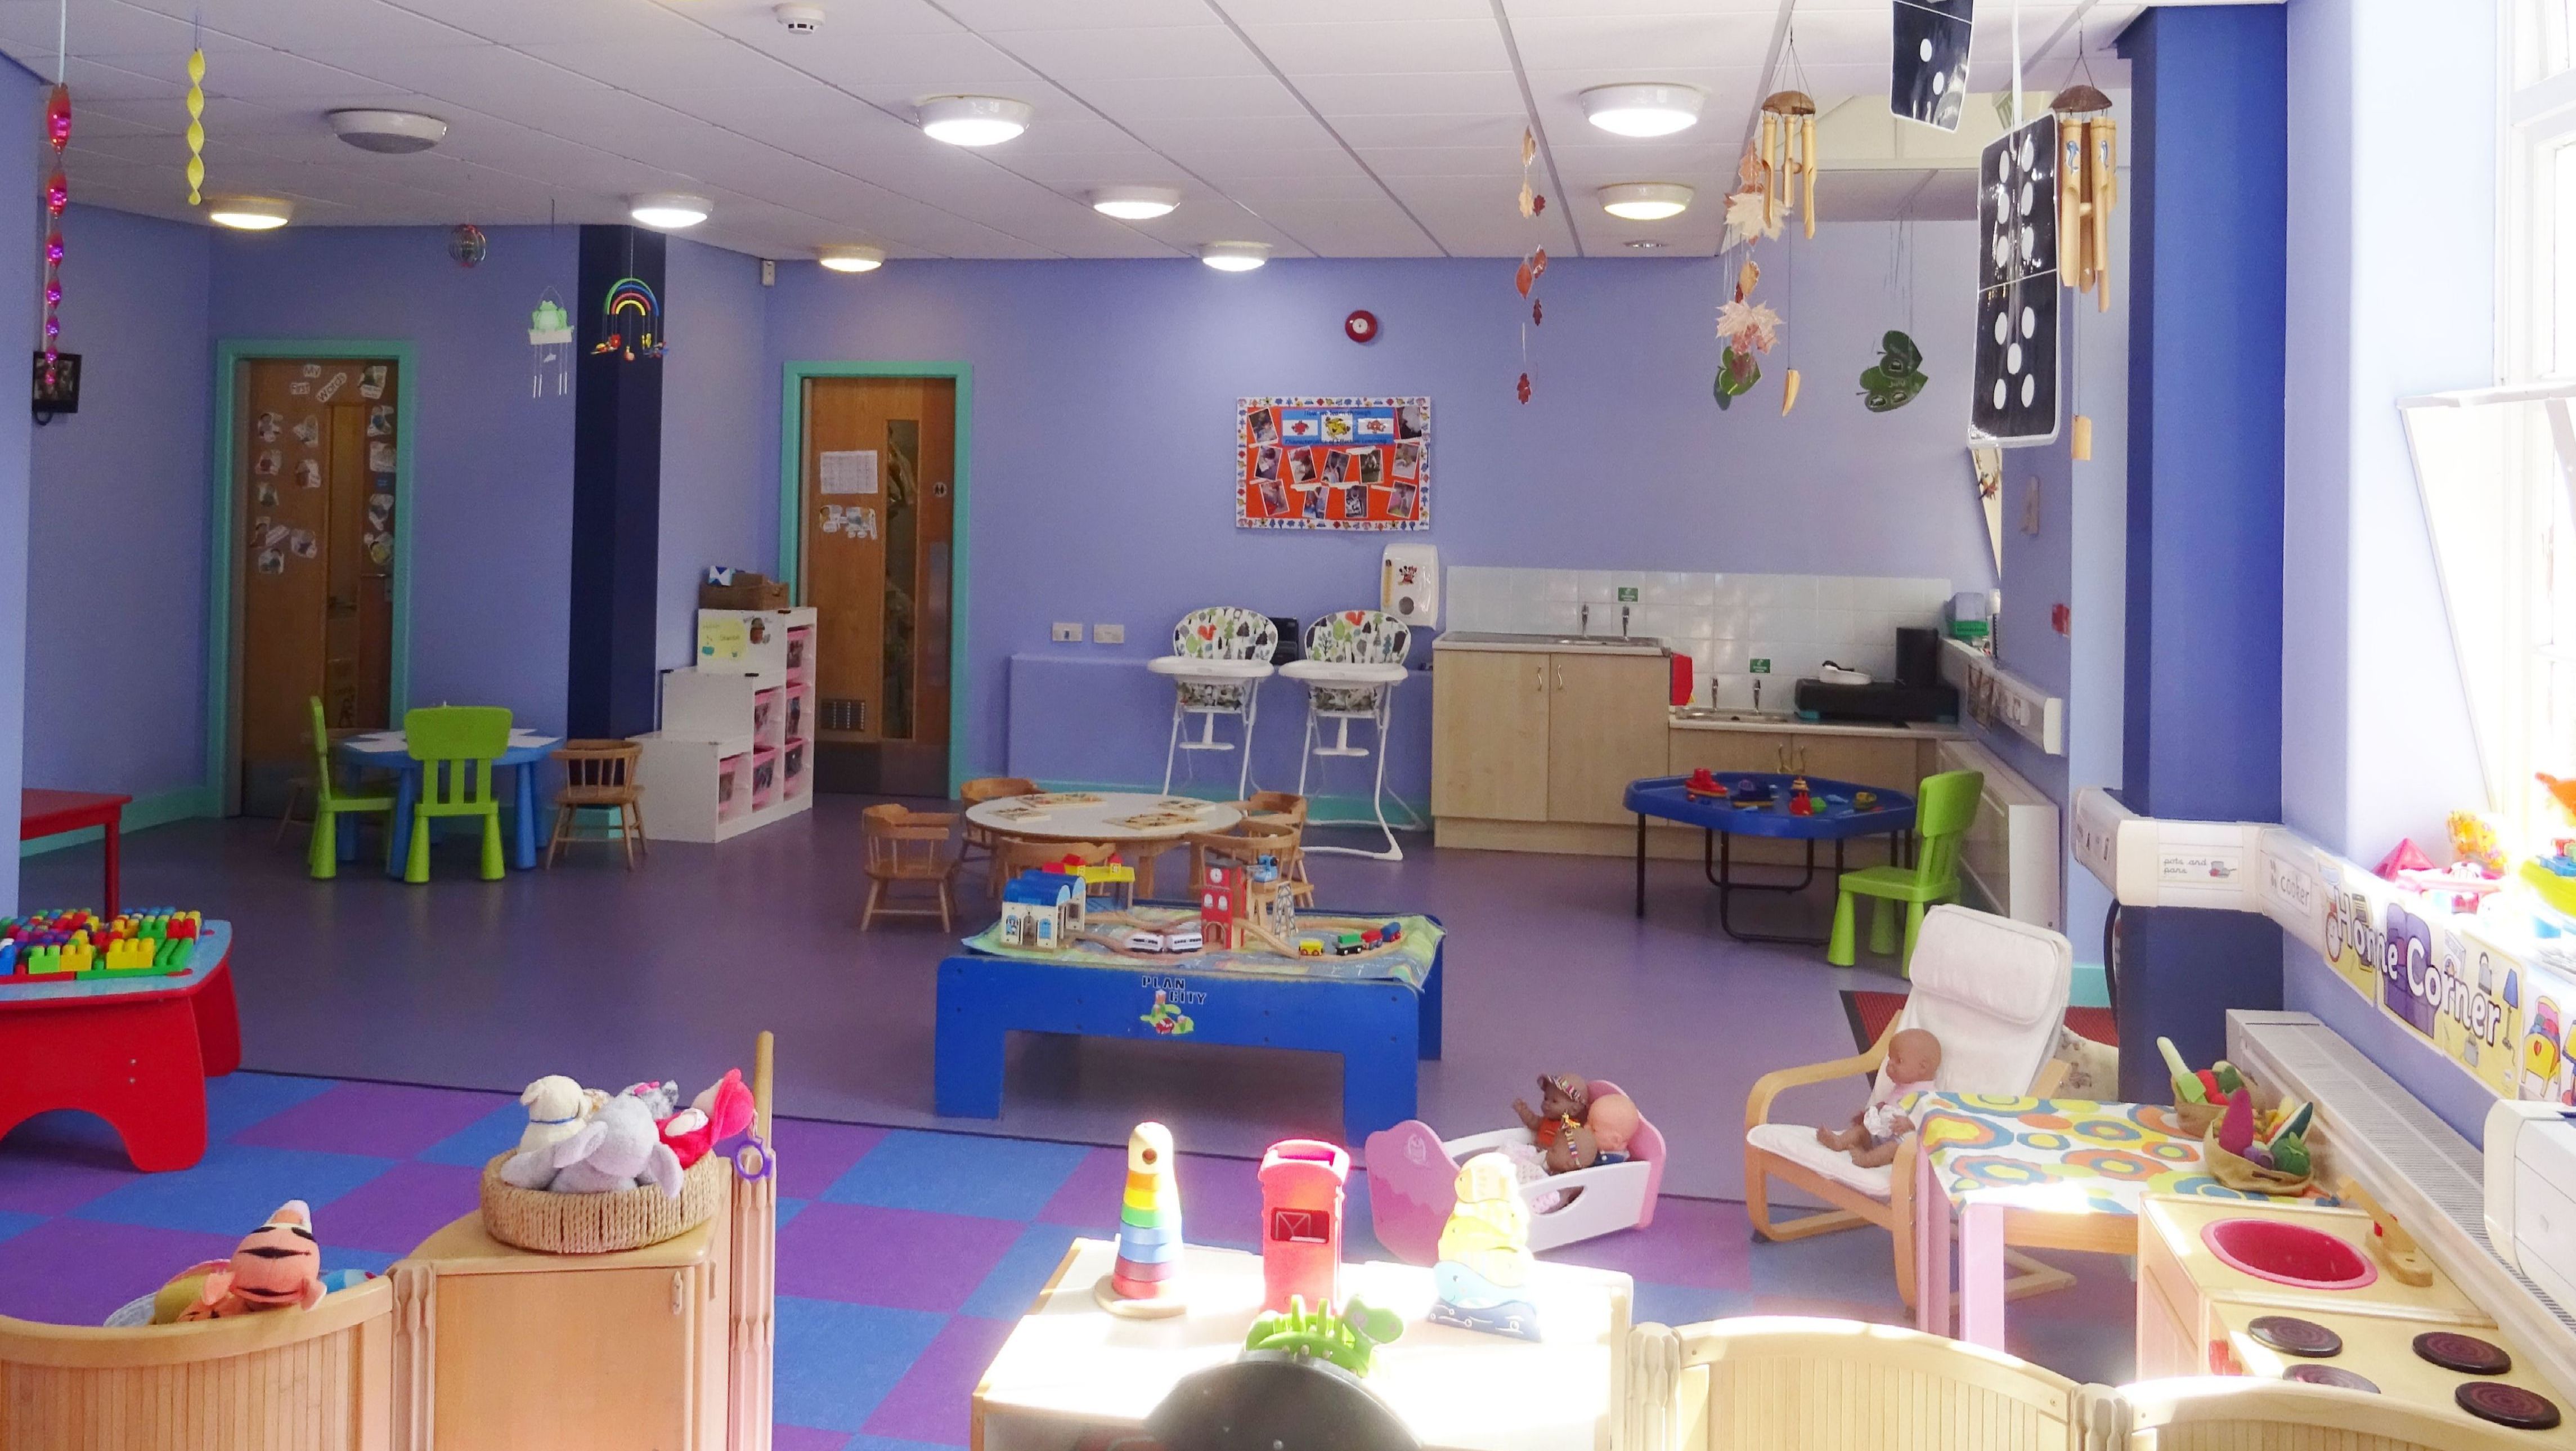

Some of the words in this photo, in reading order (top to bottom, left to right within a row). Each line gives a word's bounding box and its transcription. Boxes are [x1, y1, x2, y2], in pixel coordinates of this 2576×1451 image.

[317, 373, 346, 402] Words
[2164, 857, 2184, 866] pots
[2280, 875, 2310, 907] cooker
[2334, 885, 2399, 980] Home
[2407, 935, 2501, 1048] Corner
[1142, 975, 1186, 991] PLAN
[1169, 990, 1207, 1005] CITY
